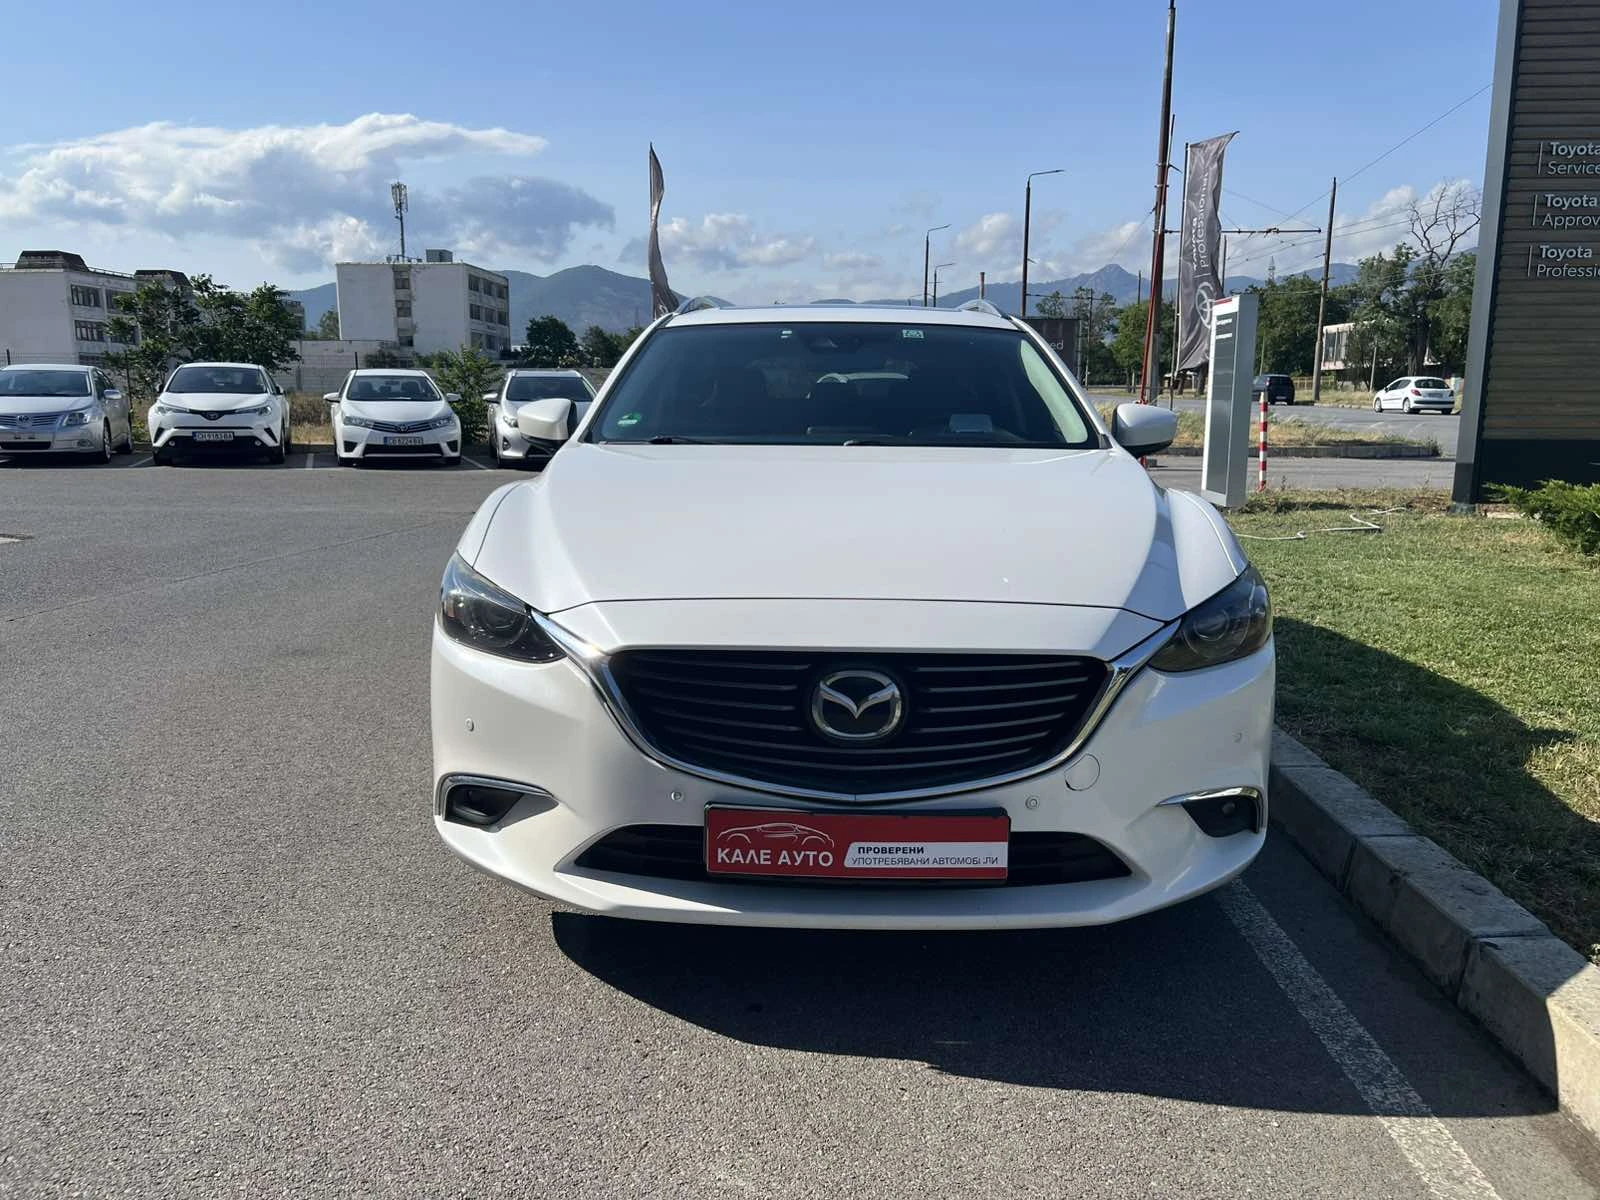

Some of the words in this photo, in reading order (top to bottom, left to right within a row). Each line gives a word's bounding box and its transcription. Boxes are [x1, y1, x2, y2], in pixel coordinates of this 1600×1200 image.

[1550, 142, 1600, 158] Toyota
[1544, 194, 1598, 210] Toyota
[1542, 213, 1600, 229] Approv
[1540, 245, 1593, 261] Toyota
[1536, 263, 1600, 277] Professi
[717, 847, 772, 865] КАЛЕ
[777, 849, 834, 867] АУТО
[857, 846, 924, 855] ПРОВЕРЕНИ
[851, 856, 930, 866] УПОТРЕБЯВАНИ
